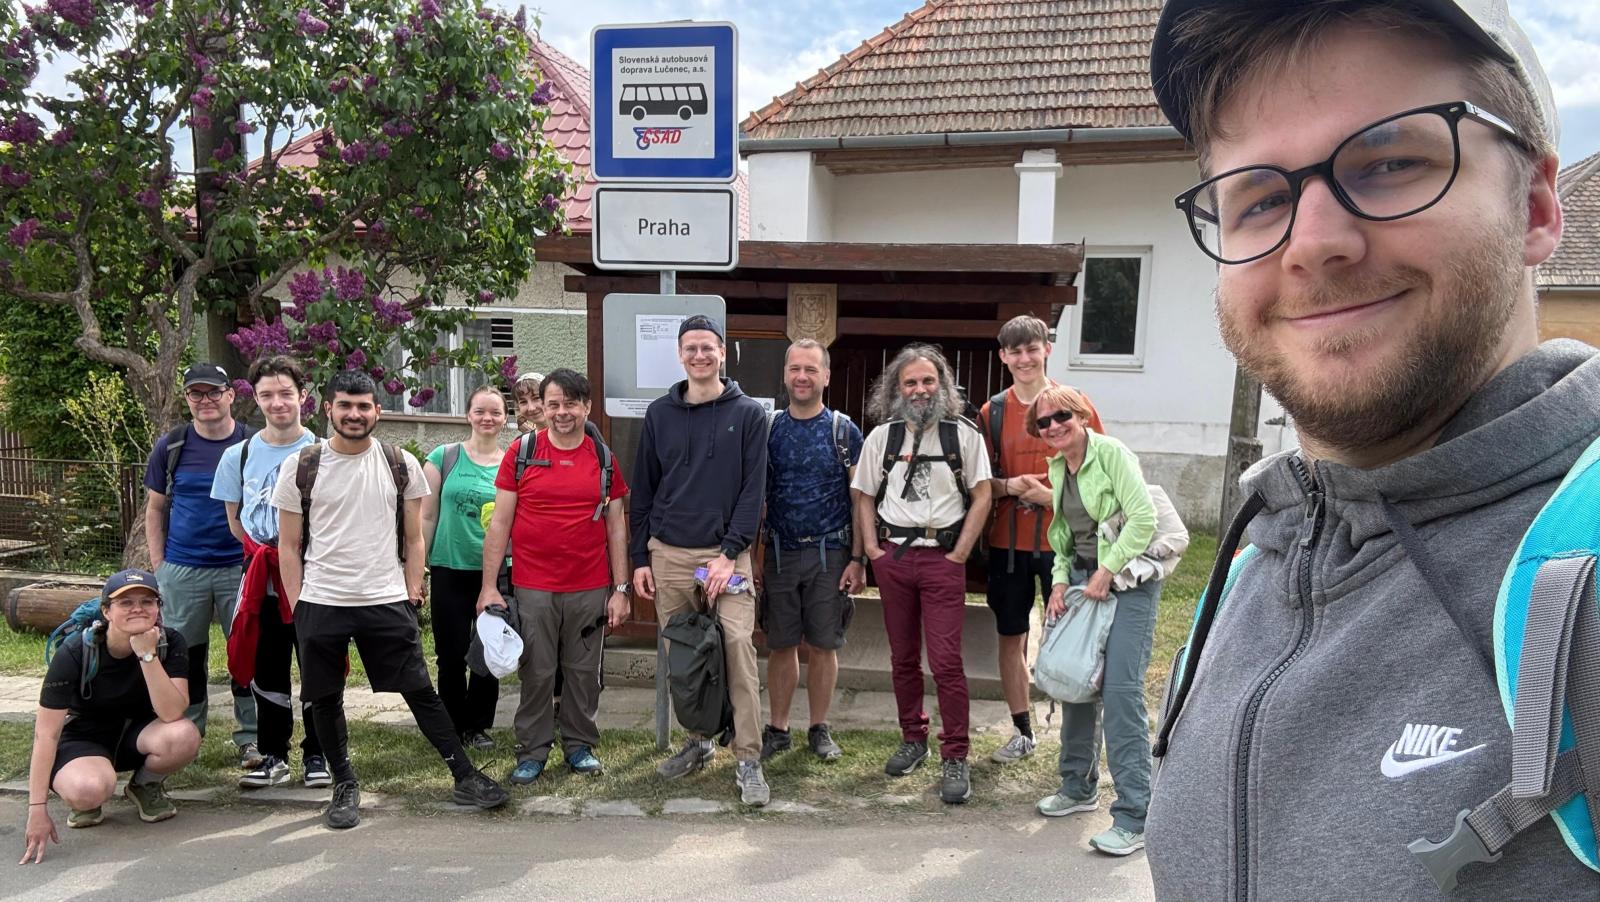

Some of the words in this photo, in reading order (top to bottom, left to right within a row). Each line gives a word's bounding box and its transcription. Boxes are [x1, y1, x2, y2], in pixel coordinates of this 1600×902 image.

[618, 55, 660, 64] Slovenská
[661, 54, 708, 63] autobusová
[620, 65, 653, 75] doprava
[654, 65, 690, 74] Lučenec,
[638, 217, 690, 236] Praha
[1395, 723, 1464, 757] NIKE
